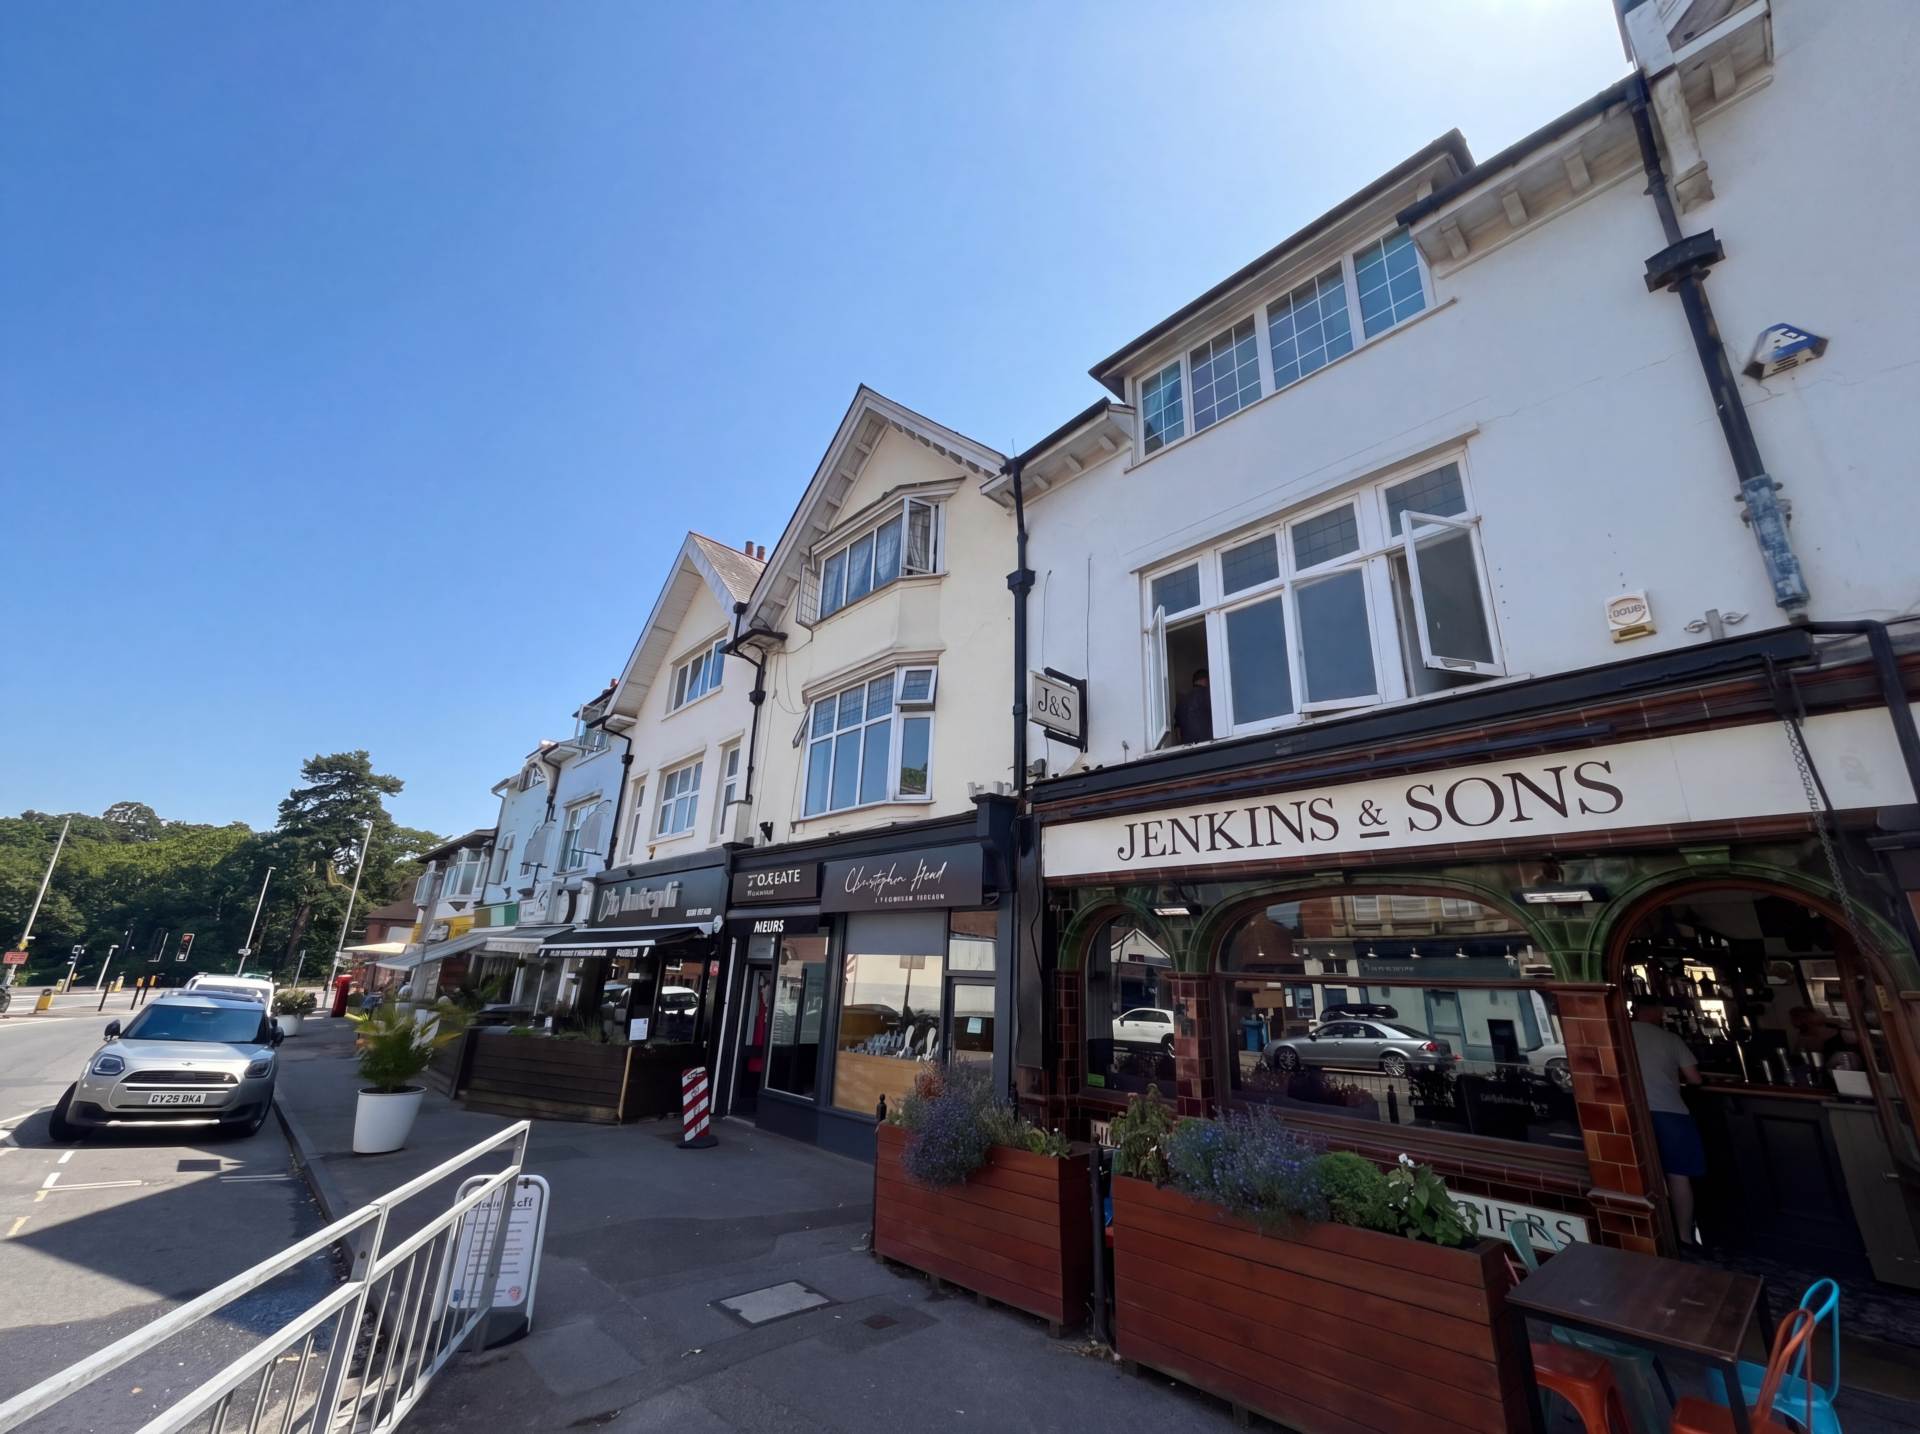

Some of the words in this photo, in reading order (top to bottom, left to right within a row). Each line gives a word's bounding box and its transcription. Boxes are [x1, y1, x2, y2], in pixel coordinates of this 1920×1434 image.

[1037, 686, 1072, 721] J&S
[1117, 798, 1340, 861] JENKINS
[1358, 799, 1390, 832] &
[1405, 761, 1624, 832] SONS
